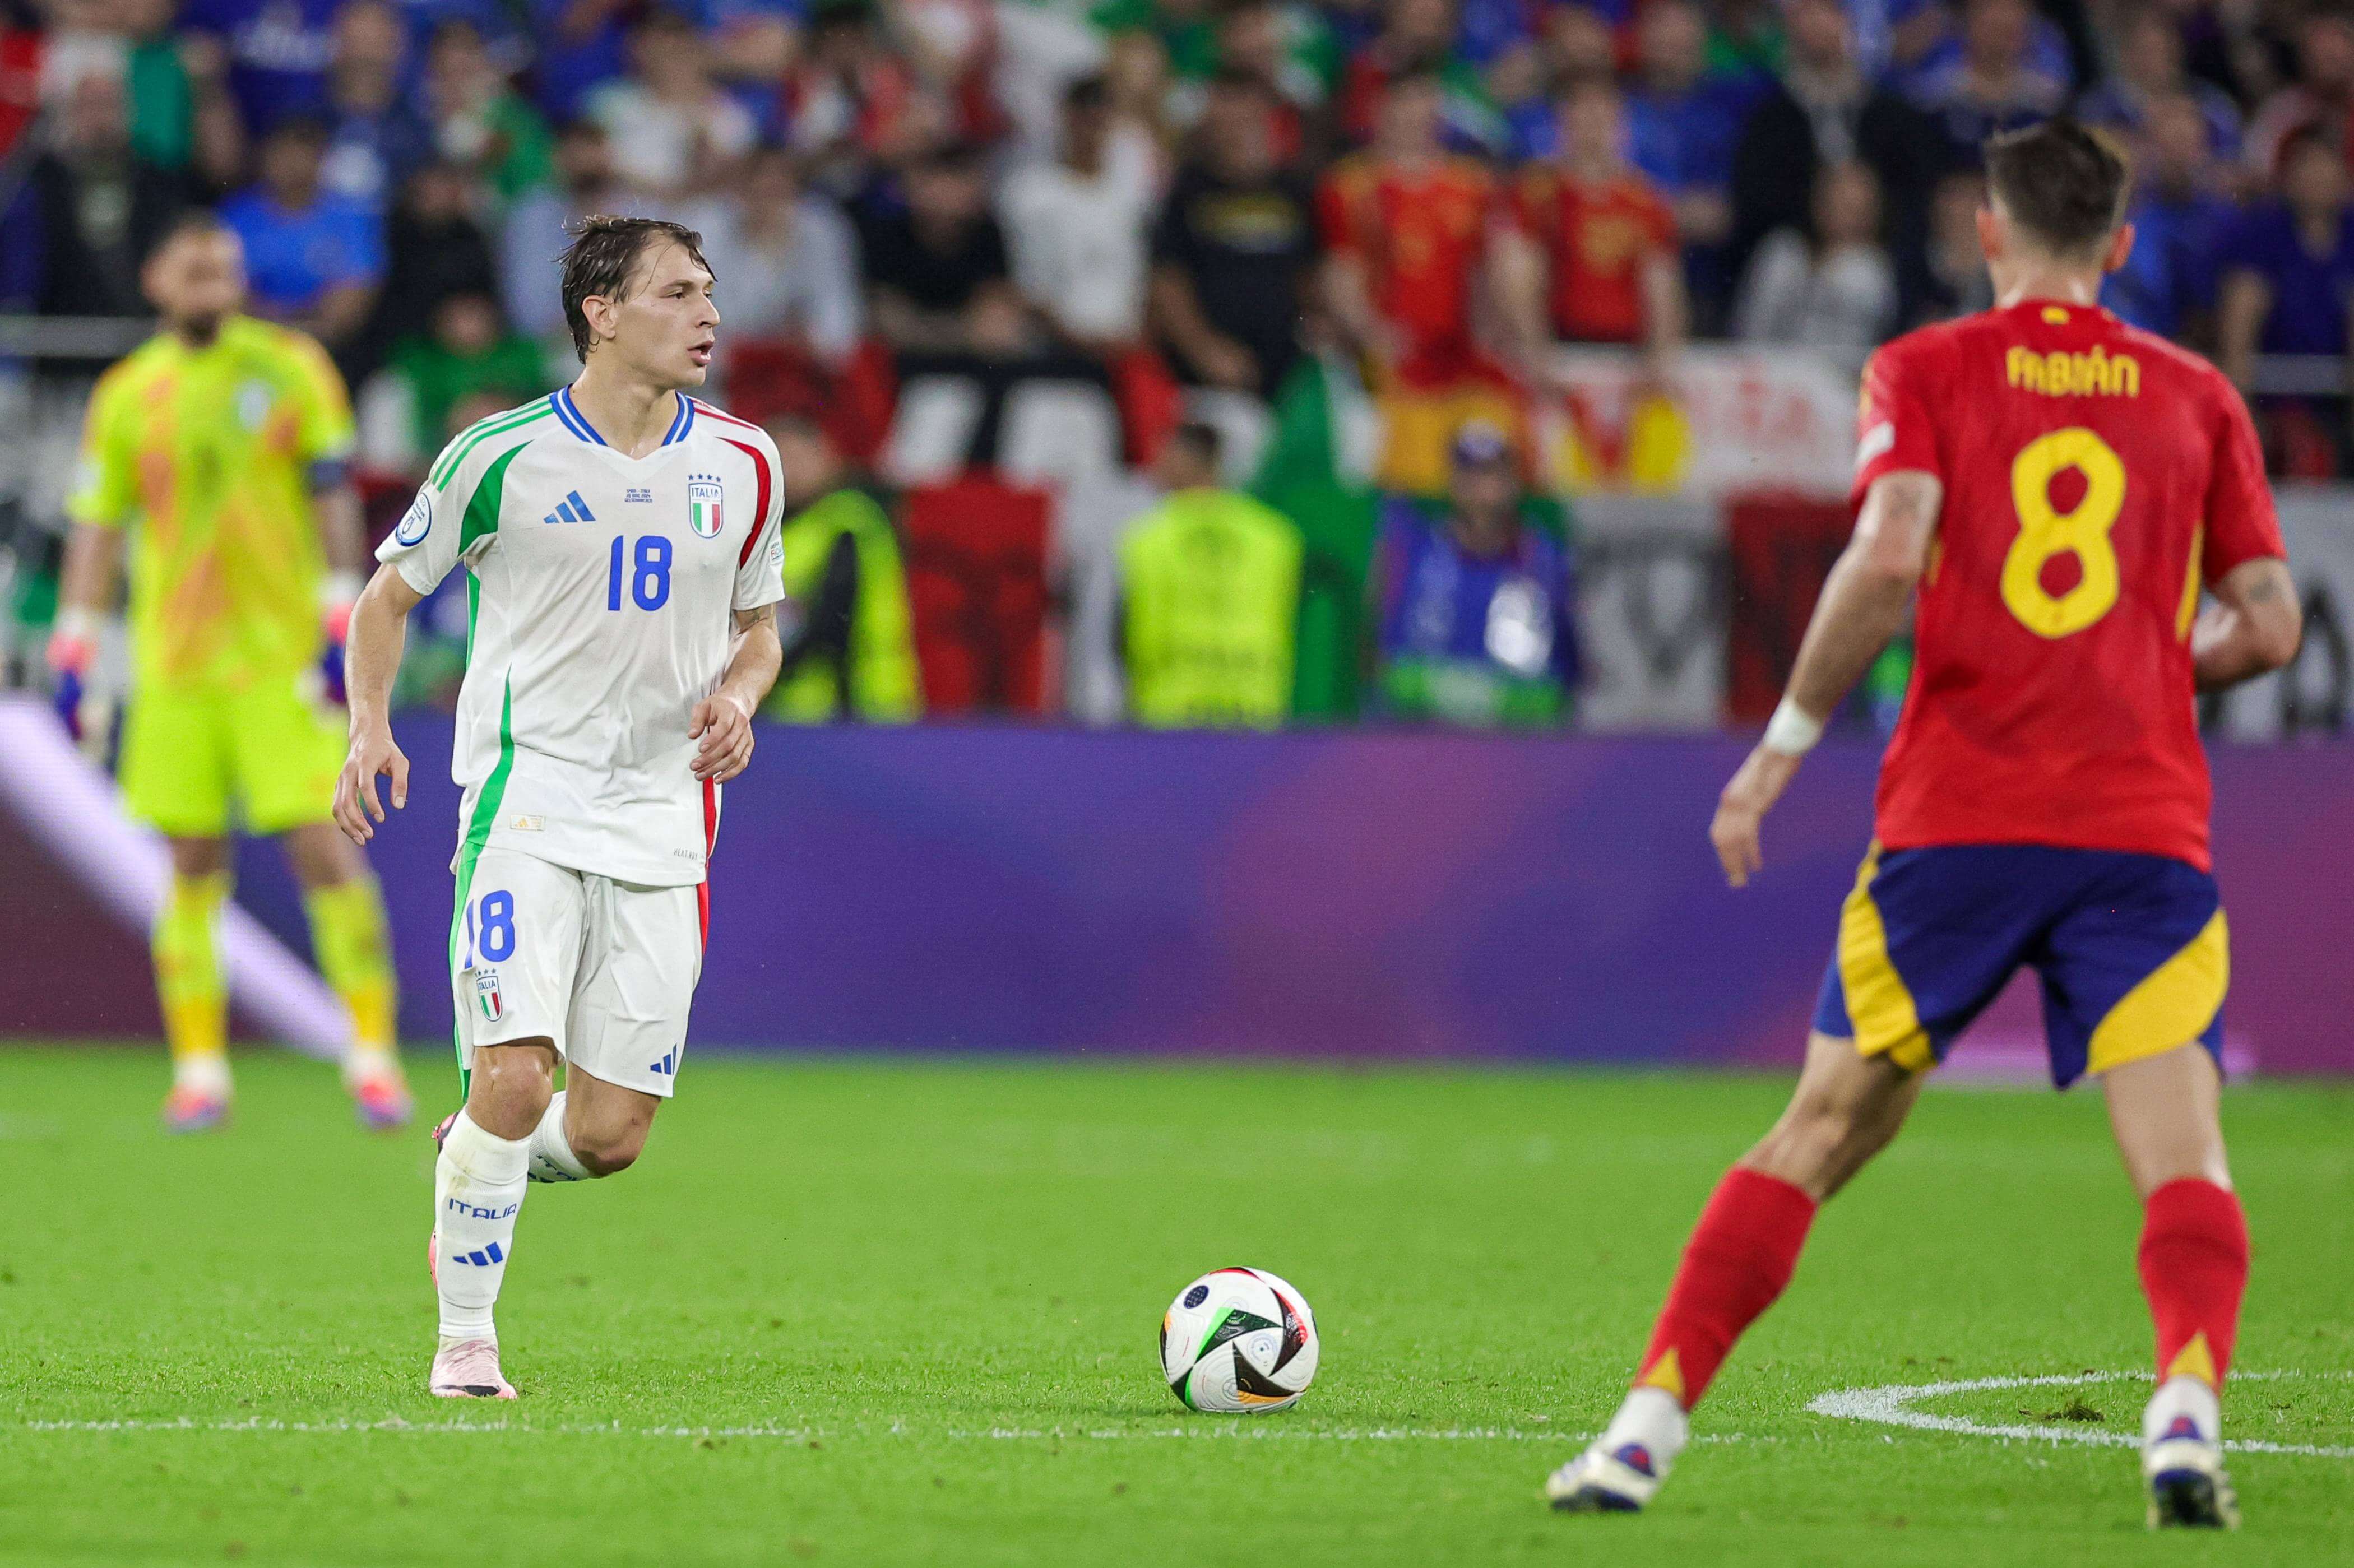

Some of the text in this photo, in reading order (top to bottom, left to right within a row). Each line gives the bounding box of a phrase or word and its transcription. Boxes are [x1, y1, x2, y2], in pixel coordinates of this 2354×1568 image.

[691, 487, 720, 499] ITALIA
[2000, 426, 2126, 639] 8
[608, 535, 673, 611] 18
[464, 890, 516, 970] 18
[449, 1198, 517, 1220] ITALIA
